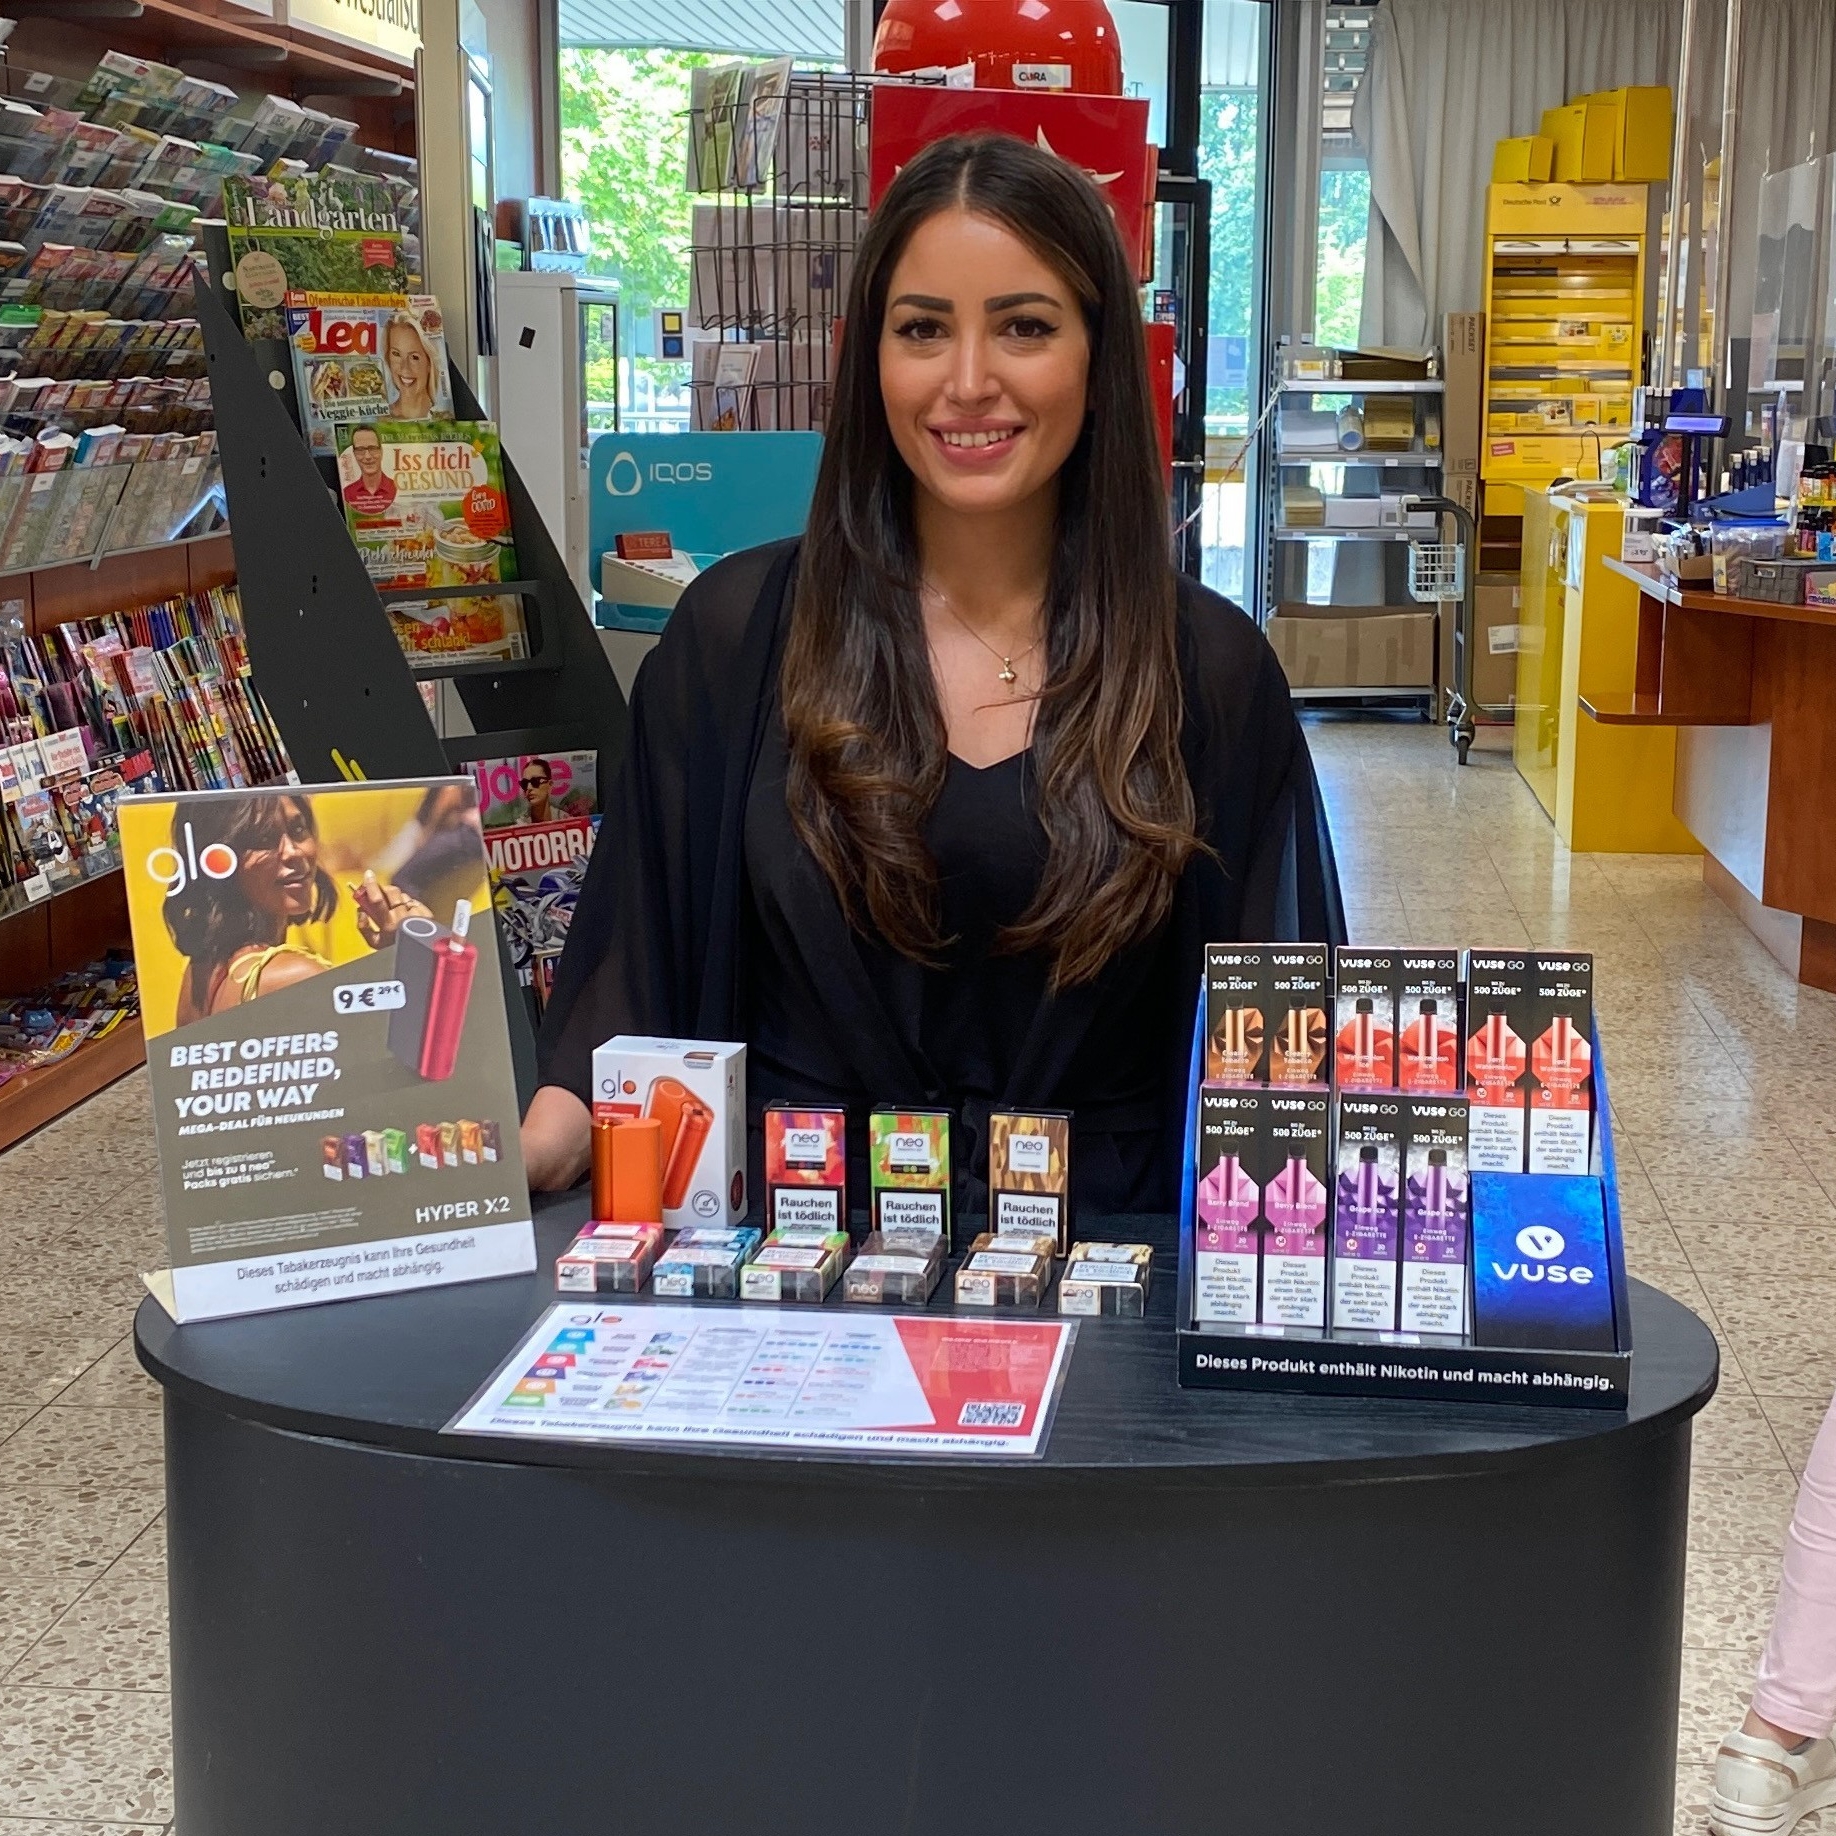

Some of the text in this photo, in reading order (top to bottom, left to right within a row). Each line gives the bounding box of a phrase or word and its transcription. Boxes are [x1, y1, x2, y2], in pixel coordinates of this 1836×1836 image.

[309, 310, 377, 355] Lea
[393, 446, 471, 471] Iss dich
[649, 462, 713, 484] IQOS
[393, 470, 475, 491] GESUND
[147, 822, 238, 897] glo
[1243, 956, 1260, 965] GO
[1306, 956, 1323, 965] GO
[1374, 960, 1391, 969] GO
[1437, 960, 1455, 969] GO
[1507, 961, 1525, 970] GO
[1572, 962, 1590, 972] GO
[1212, 982, 1228, 990] 500
[1274, 982, 1290, 990] 500
[1342, 985, 1358, 993] 500
[1474, 987, 1490, 995] 500
[1539, 988, 1555, 996] 500
[170, 1030, 339, 1067] BEST OFFERS
[191, 1057, 341, 1091] REDEFINED,
[601, 1069, 637, 1100] glo
[174, 1083, 320, 1119] YOUR WAY
[1240, 1099, 1258, 1108] GO
[1307, 1101, 1326, 1111] GO
[1380, 1105, 1398, 1114] GO
[1448, 1107, 1467, 1117] GO
[178, 1107, 345, 1136] MEGA-DEAL FÜR NEUKUNDEN
[1205, 1126, 1222, 1135] 500
[1273, 1128, 1290, 1137] 500
[1344, 1131, 1361, 1140] 500
[791, 1133, 820, 1144] neo
[896, 1136, 924, 1147] neo
[1413, 1134, 1430, 1143] 500
[1016, 1140, 1043, 1151] neo
[780, 1197, 832, 1209] Rauchen
[886, 1200, 937, 1212] Rauchen
[1003, 1202, 1054, 1215] Rauchen
[415, 1196, 511, 1224] HYPER X2
[778, 1210, 835, 1222] ist tödlich
[883, 1213, 940, 1225] ist tödlich
[1000, 1214, 1056, 1227] ist tödlich
[237, 1235, 476, 1280] Dieses Tabakerzeugnis kann Ihre Gesundheit
[275, 1260, 444, 1294] schädigen und macht abhängig.
[1196, 1354, 1615, 1392] Dieses Produkt enthält Nikotin und macht abhängig.
